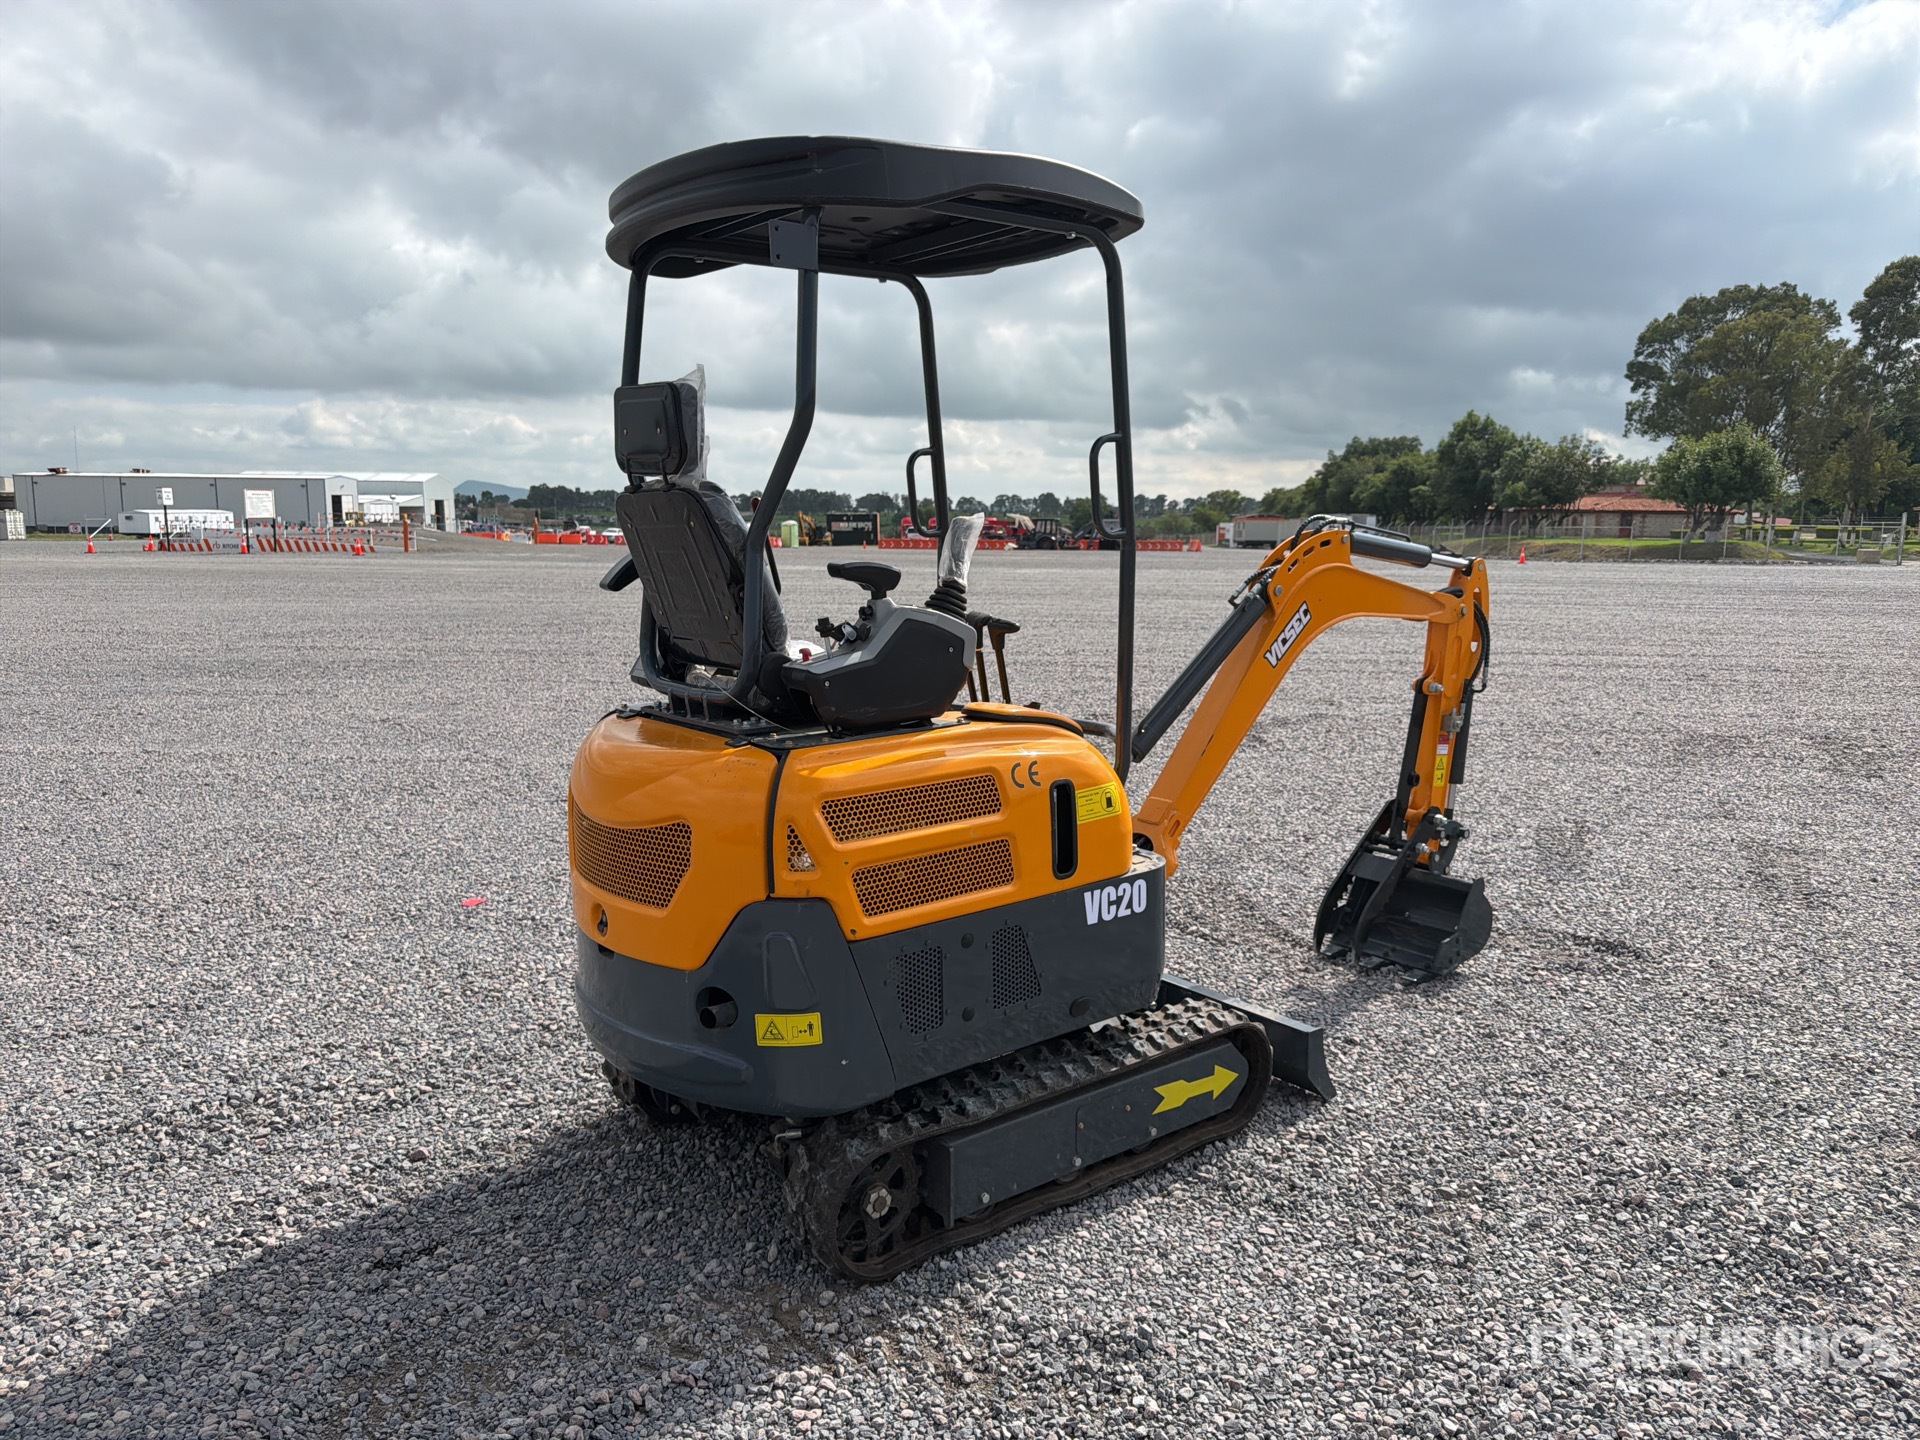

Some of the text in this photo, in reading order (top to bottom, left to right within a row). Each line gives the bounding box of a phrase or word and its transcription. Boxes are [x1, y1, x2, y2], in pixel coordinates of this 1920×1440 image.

[1264, 602, 1312, 668] VICSEC
[1011, 760, 1041, 788] CE
[1084, 879, 1147, 925] VC20
